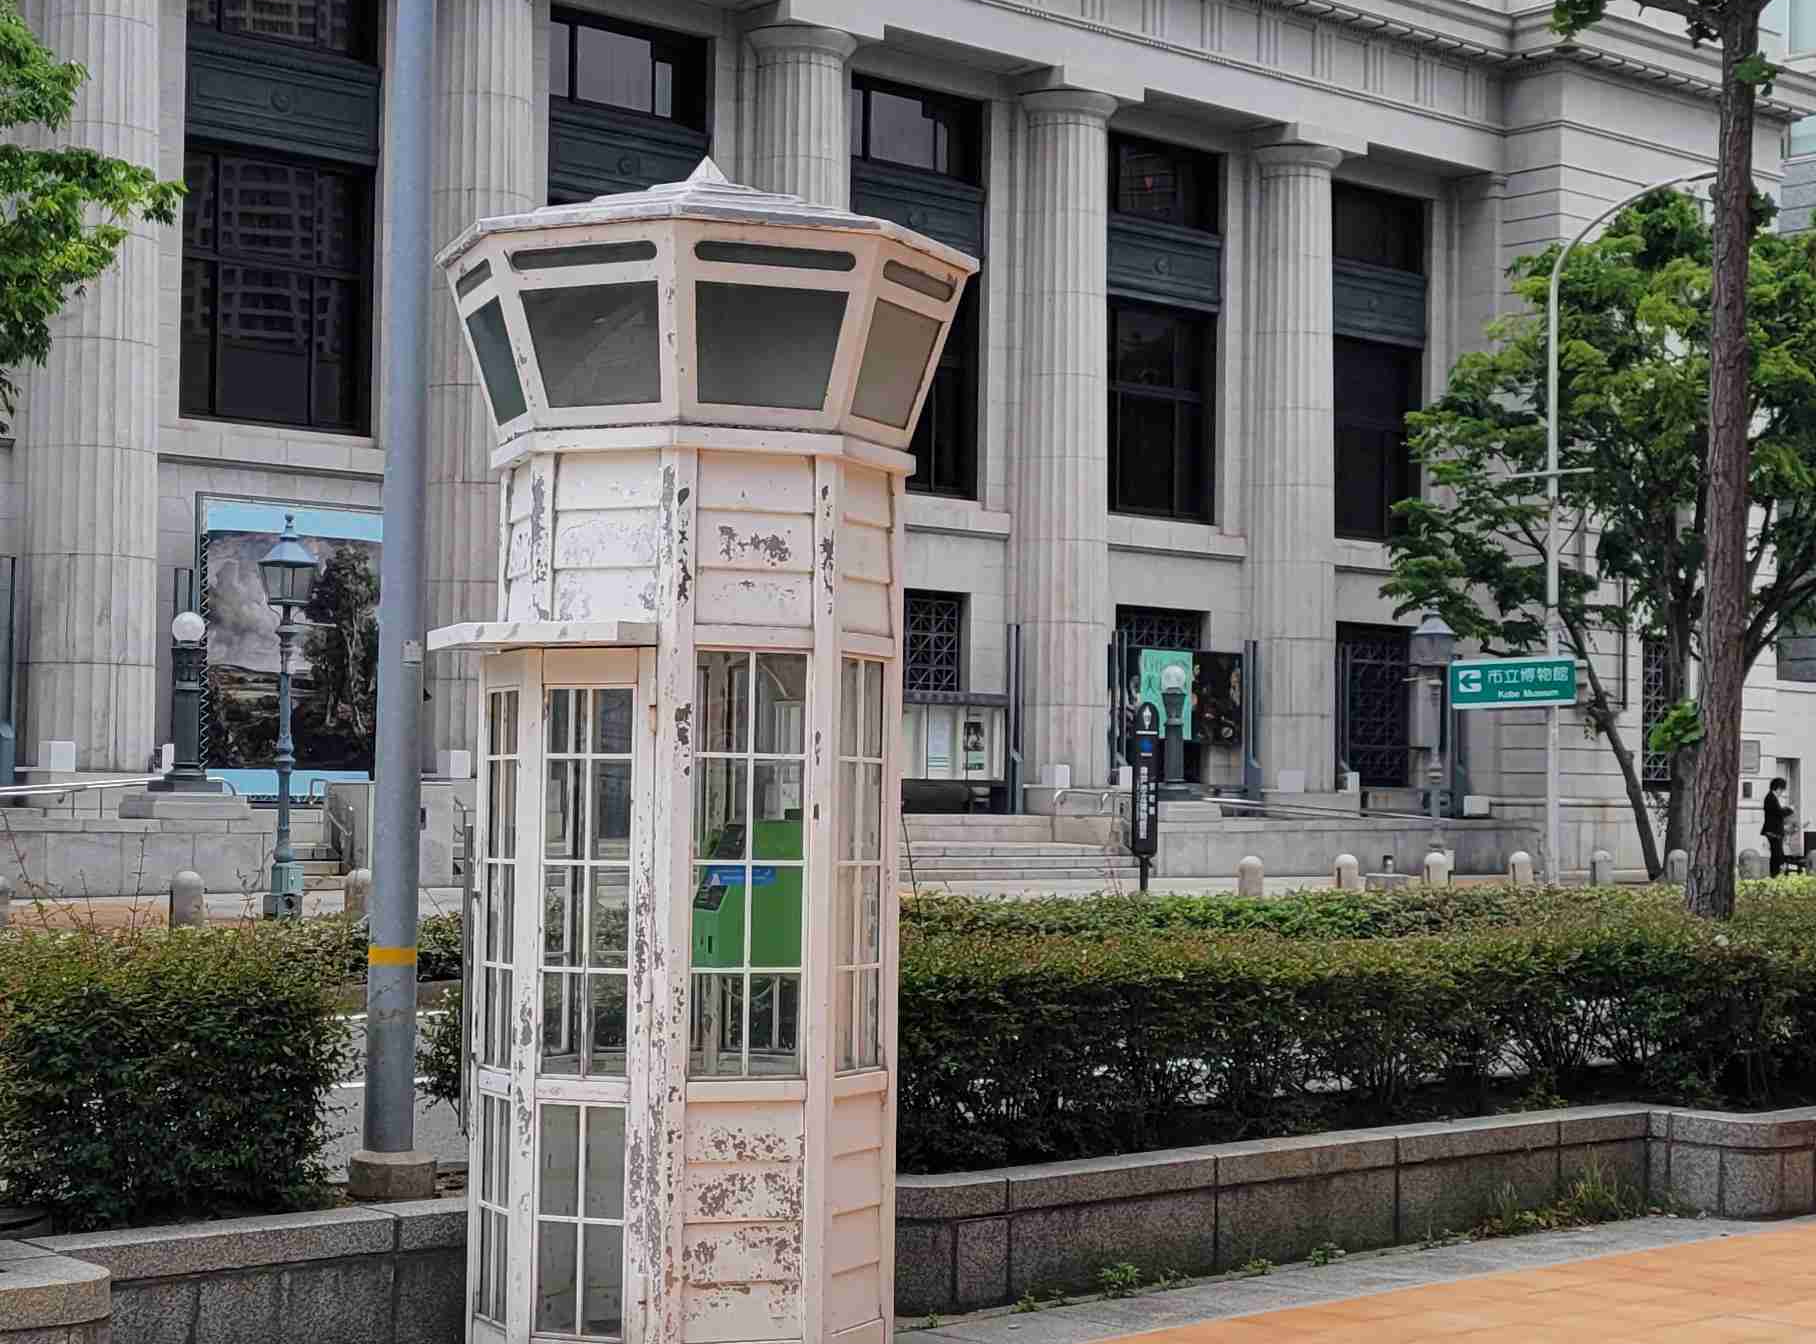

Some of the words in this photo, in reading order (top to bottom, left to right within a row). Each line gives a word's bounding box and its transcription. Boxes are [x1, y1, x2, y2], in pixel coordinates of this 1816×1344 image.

[1487, 666, 1569, 684] 市立博物館
